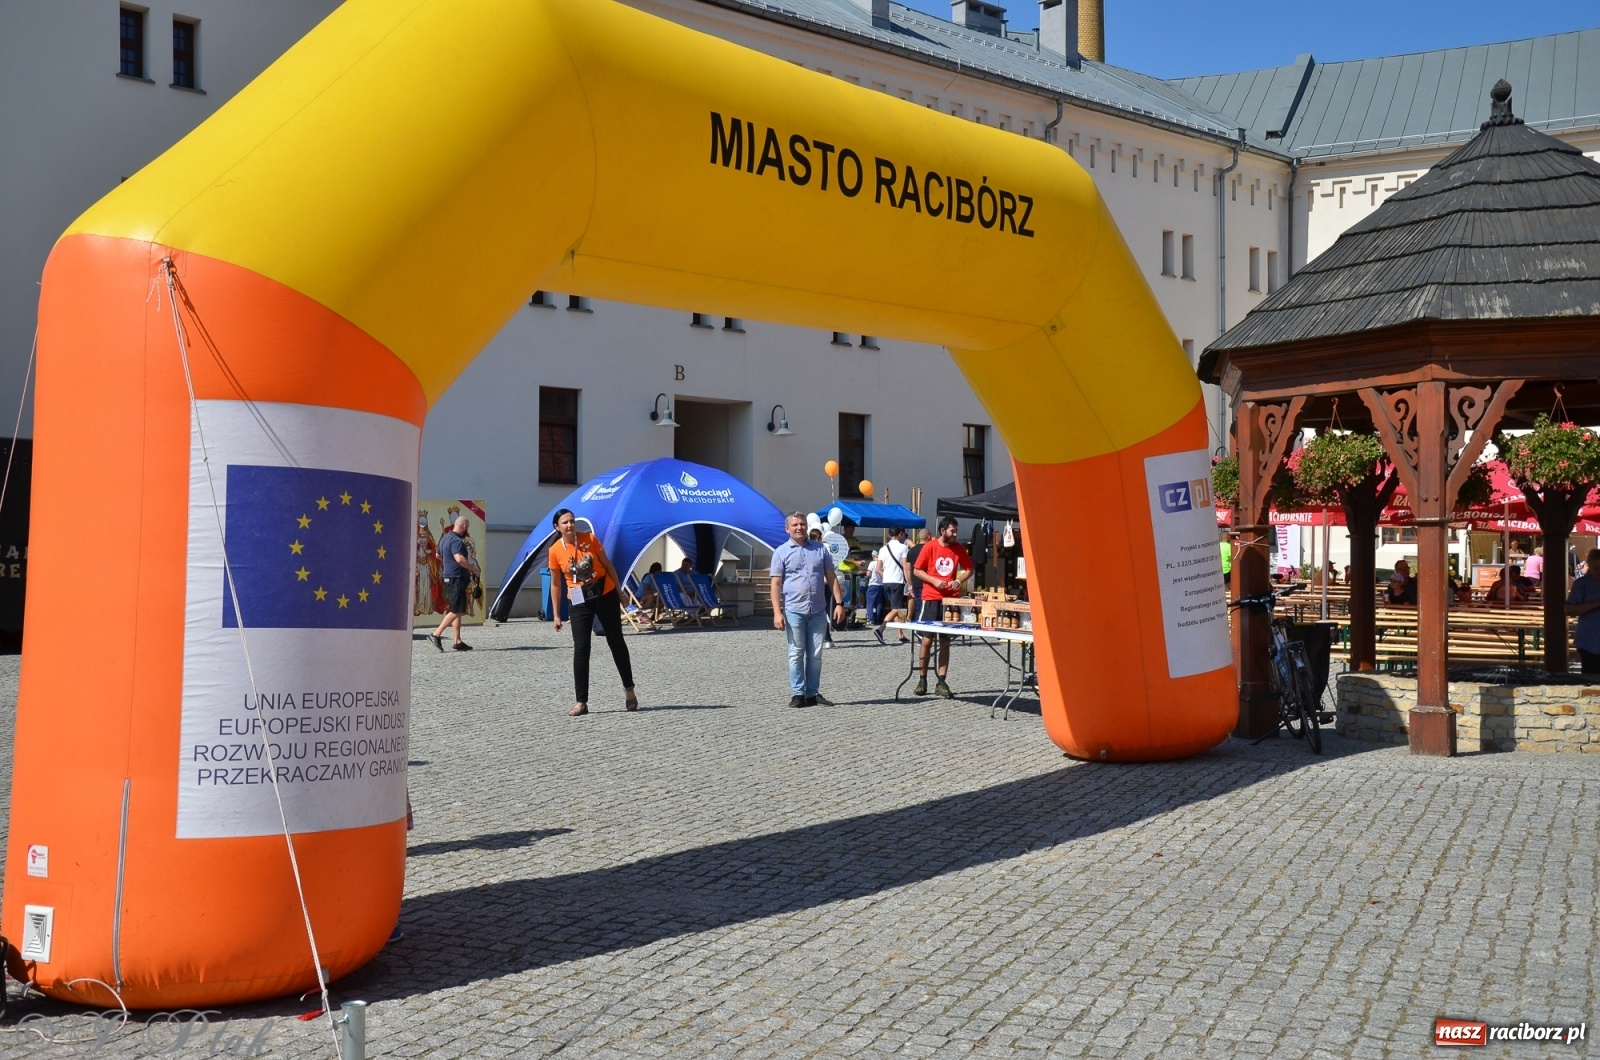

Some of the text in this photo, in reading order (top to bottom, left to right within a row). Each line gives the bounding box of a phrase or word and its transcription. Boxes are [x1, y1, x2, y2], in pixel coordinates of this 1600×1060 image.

[709, 111, 1035, 238] MIASTO RACIBÓRZ
[674, 365, 685, 381] B
[682, 496, 735, 504] Raciborskie
[1269, 512, 1313, 522] ACIBORSKIE
[244, 690, 400, 711] UNIA EUROPEJSKA
[219, 712, 406, 736] EUROPEJSKI FUNDUSZ
[194, 735, 408, 762] ROZWOJU REGIONALNEG
[198, 761, 366, 786] PRZEKRACZAMY
